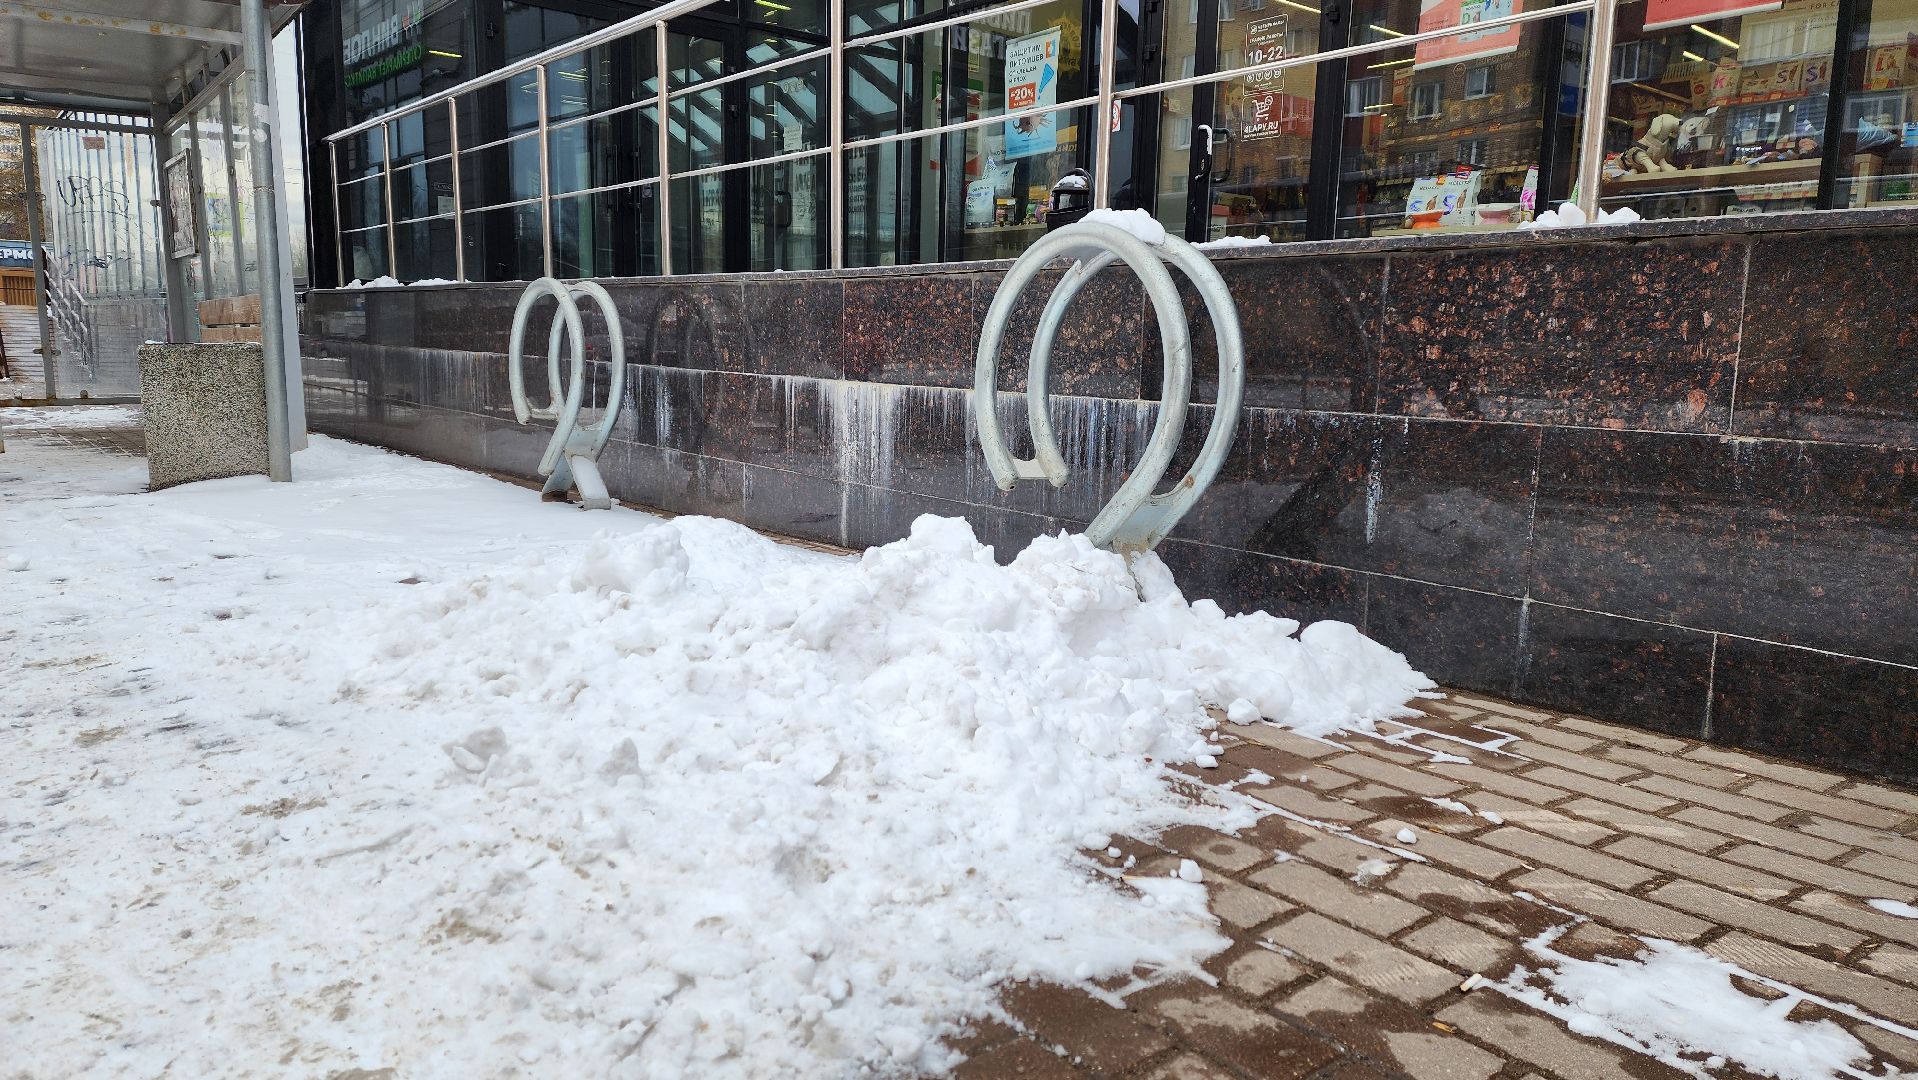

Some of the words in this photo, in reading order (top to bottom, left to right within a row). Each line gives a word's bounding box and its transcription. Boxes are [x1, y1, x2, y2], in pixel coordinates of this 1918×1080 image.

[1010, 44, 1041, 58] ЗАЩИТИМ
[1248, 45, 1284, 65] 10-22
[1009, 53, 1044, 68] ПИТОМЦЕВ
[1010, 86, 1034, 101] -20%
[1243, 120, 1279, 134] 4LAPY.RU
